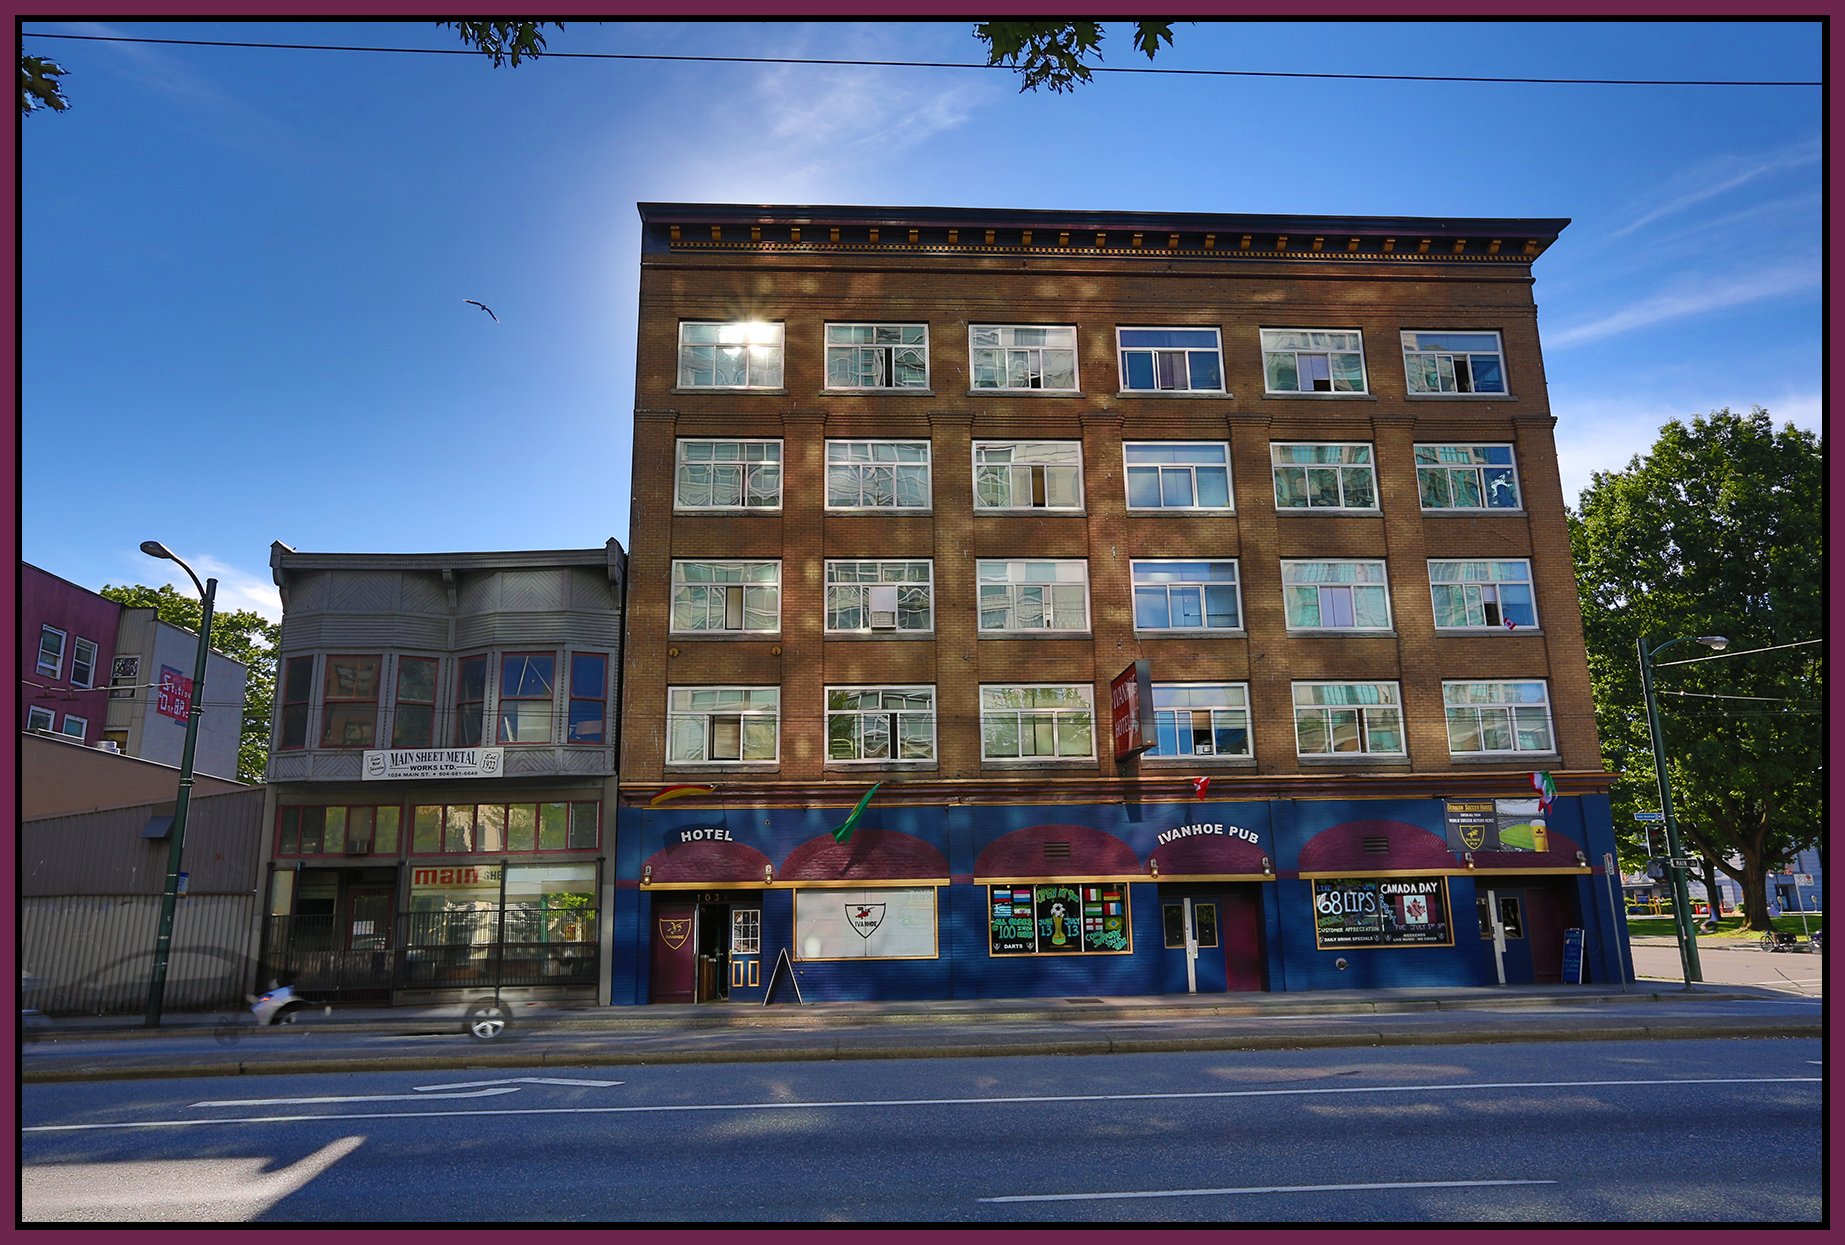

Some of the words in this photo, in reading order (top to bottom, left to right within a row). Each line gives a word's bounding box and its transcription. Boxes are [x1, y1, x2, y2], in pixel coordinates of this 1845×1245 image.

[390, 752, 413, 767] MAIN
[416, 751, 442, 763] SHEET
[445, 751, 477, 766] METAL
[482, 760, 496, 770] 1922
[440, 763, 457, 771] LTD.
[681, 828, 734, 843] HOTEL
[1157, 823, 1223, 846] IVANHOE
[1228, 825, 1260, 845] PUB
[414, 868, 479, 885] main
[1380, 883, 1418, 894] CANADA
[1418, 882, 1438, 894] DAY
[1316, 891, 1343, 915] 68
[1343, 891, 1376, 912] LIPS
[1038, 917, 1053, 926] JUNE
[1064, 917, 1080, 926] JULY
[999, 925, 1017, 939] 100
[1041, 925, 1053, 936] 13
[1067, 925, 1080, 937] 13
